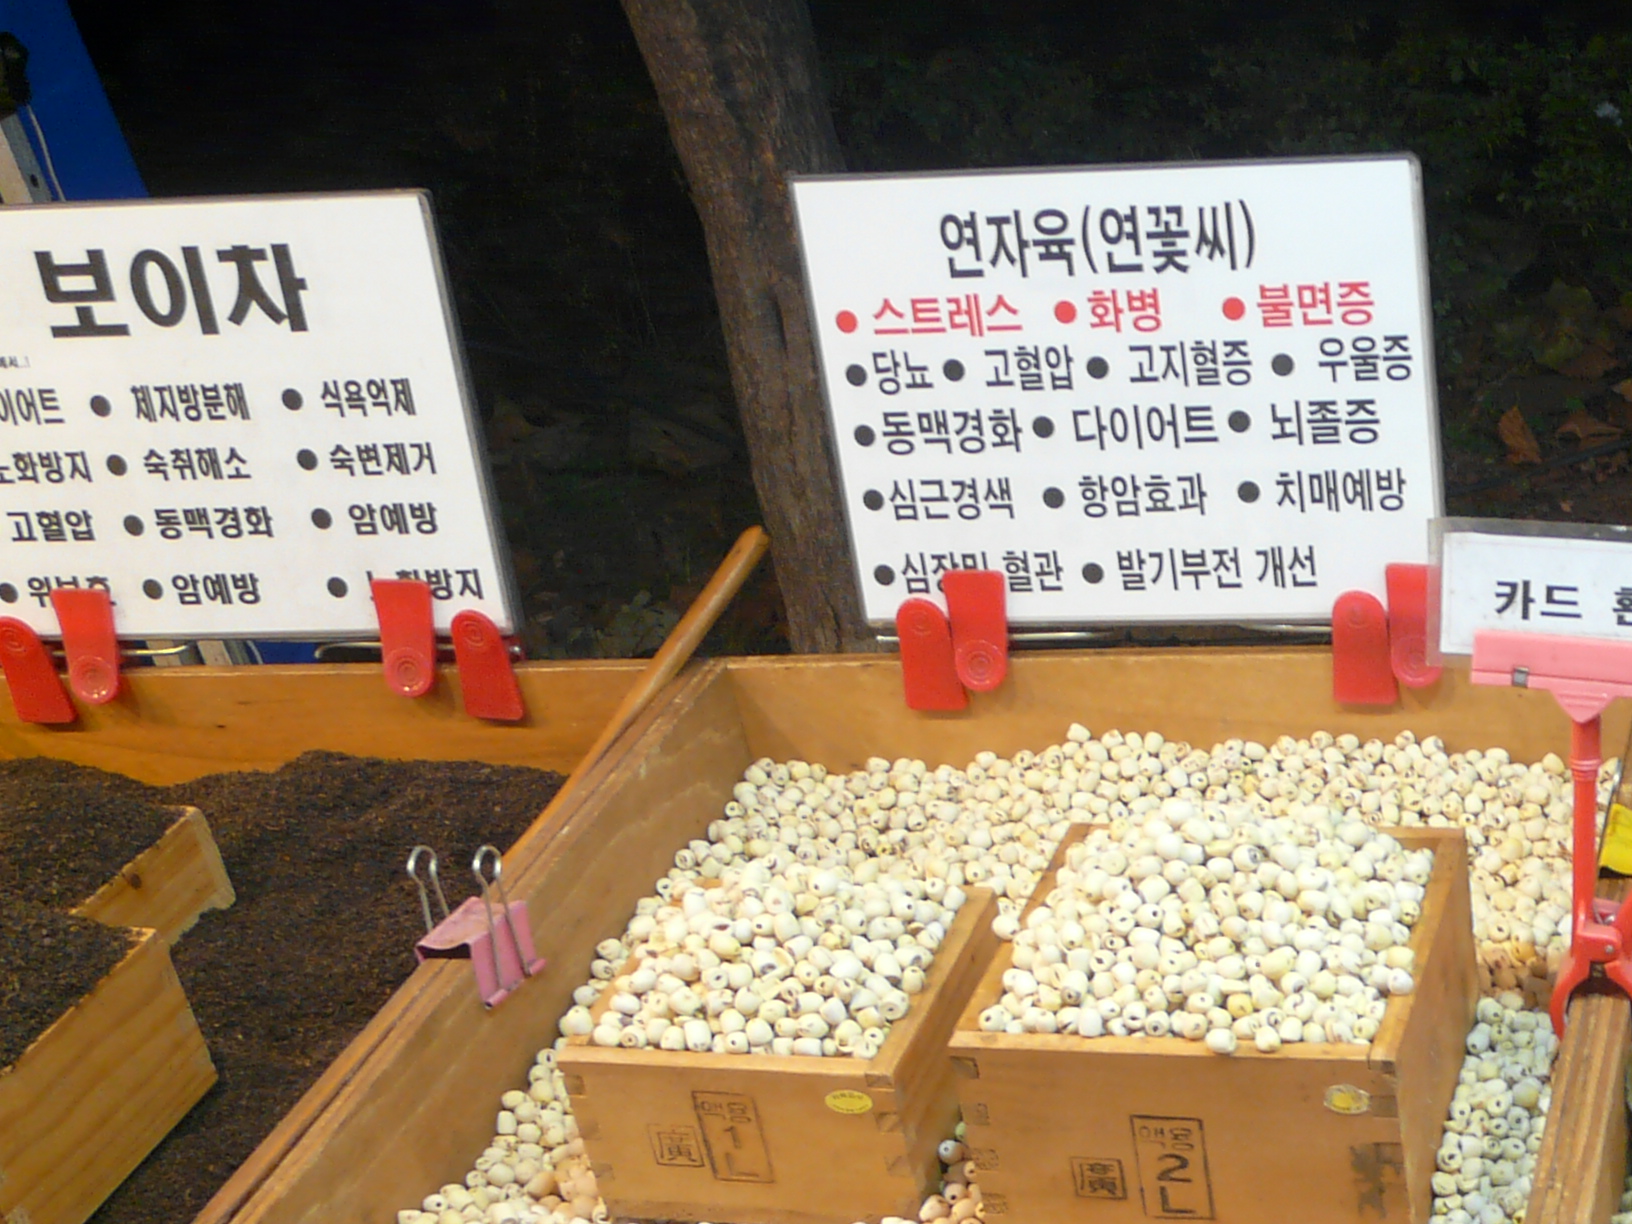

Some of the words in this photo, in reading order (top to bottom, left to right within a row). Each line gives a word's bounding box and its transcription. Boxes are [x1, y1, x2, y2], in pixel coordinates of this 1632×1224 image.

[939, 199, 1255, 279] 연자육(연꽃씨)
[33, 243, 309, 339] 보이차
[873, 293, 1023, 338] 스트레스
[1087, 287, 1162, 333] 화병
[1256, 281, 1375, 328] 불면증
[871, 349, 934, 396] 당뇨
[984, 344, 1074, 392] 고혈압
[1128, 339, 1253, 387] 고지혈증
[1318, 334, 1413, 383] 우울증
[130, 382, 251, 423] 체지방분해
[320, 377, 417, 418] 식욕억제
[882, 407, 1023, 456] 동맥경화
[1072, 403, 1219, 451] 다이어트
[1270, 398, 1381, 446] 뇌졸증
[143, 447, 252, 482] 숙취해소
[329, 441, 437, 477] 숙변제거
[889, 476, 1015, 521] 심근경색
[1078, 472, 1207, 519] 항암효과
[1275, 467, 1407, 513] 치매예방
[6, 509, 96, 543] 고혈압
[154, 506, 274, 540] 동맥경화
[348, 502, 438, 536] 암예방
[171, 572, 261, 606] 암예방
[1002, 550, 1064, 593] 혈관
[1116, 546, 1243, 591] 발기부전
[1255, 545, 1318, 589] 개선
[1495, 579, 1582, 621] 카드
